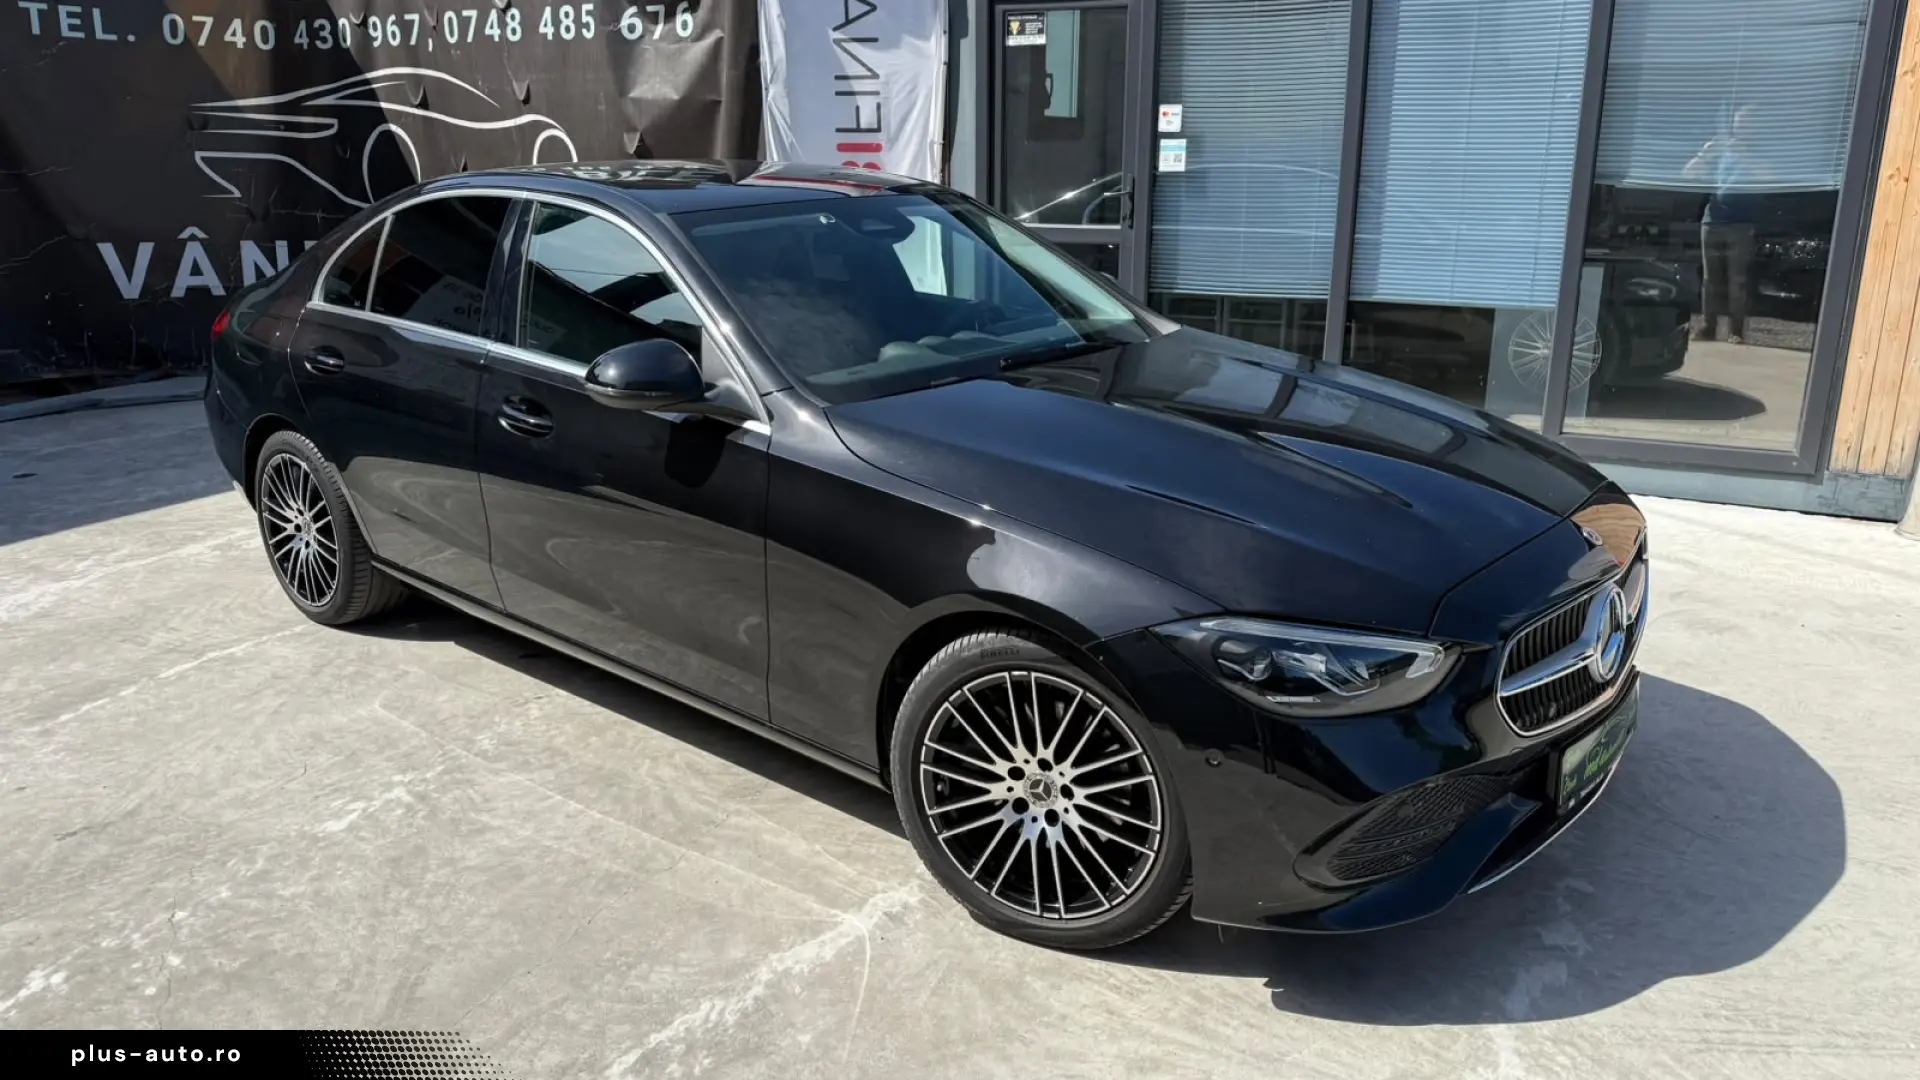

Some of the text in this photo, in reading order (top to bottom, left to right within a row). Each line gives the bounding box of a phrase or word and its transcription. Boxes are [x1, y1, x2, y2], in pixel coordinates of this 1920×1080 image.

[18, 1, 136, 42] TEL.
[162, 13, 276, 50] 0740
[294, 17, 351, 50] 430
[538, 3, 595, 40] 485
[619, 1, 695, 40] 676
[96, 226, 318, 300] VÂN
